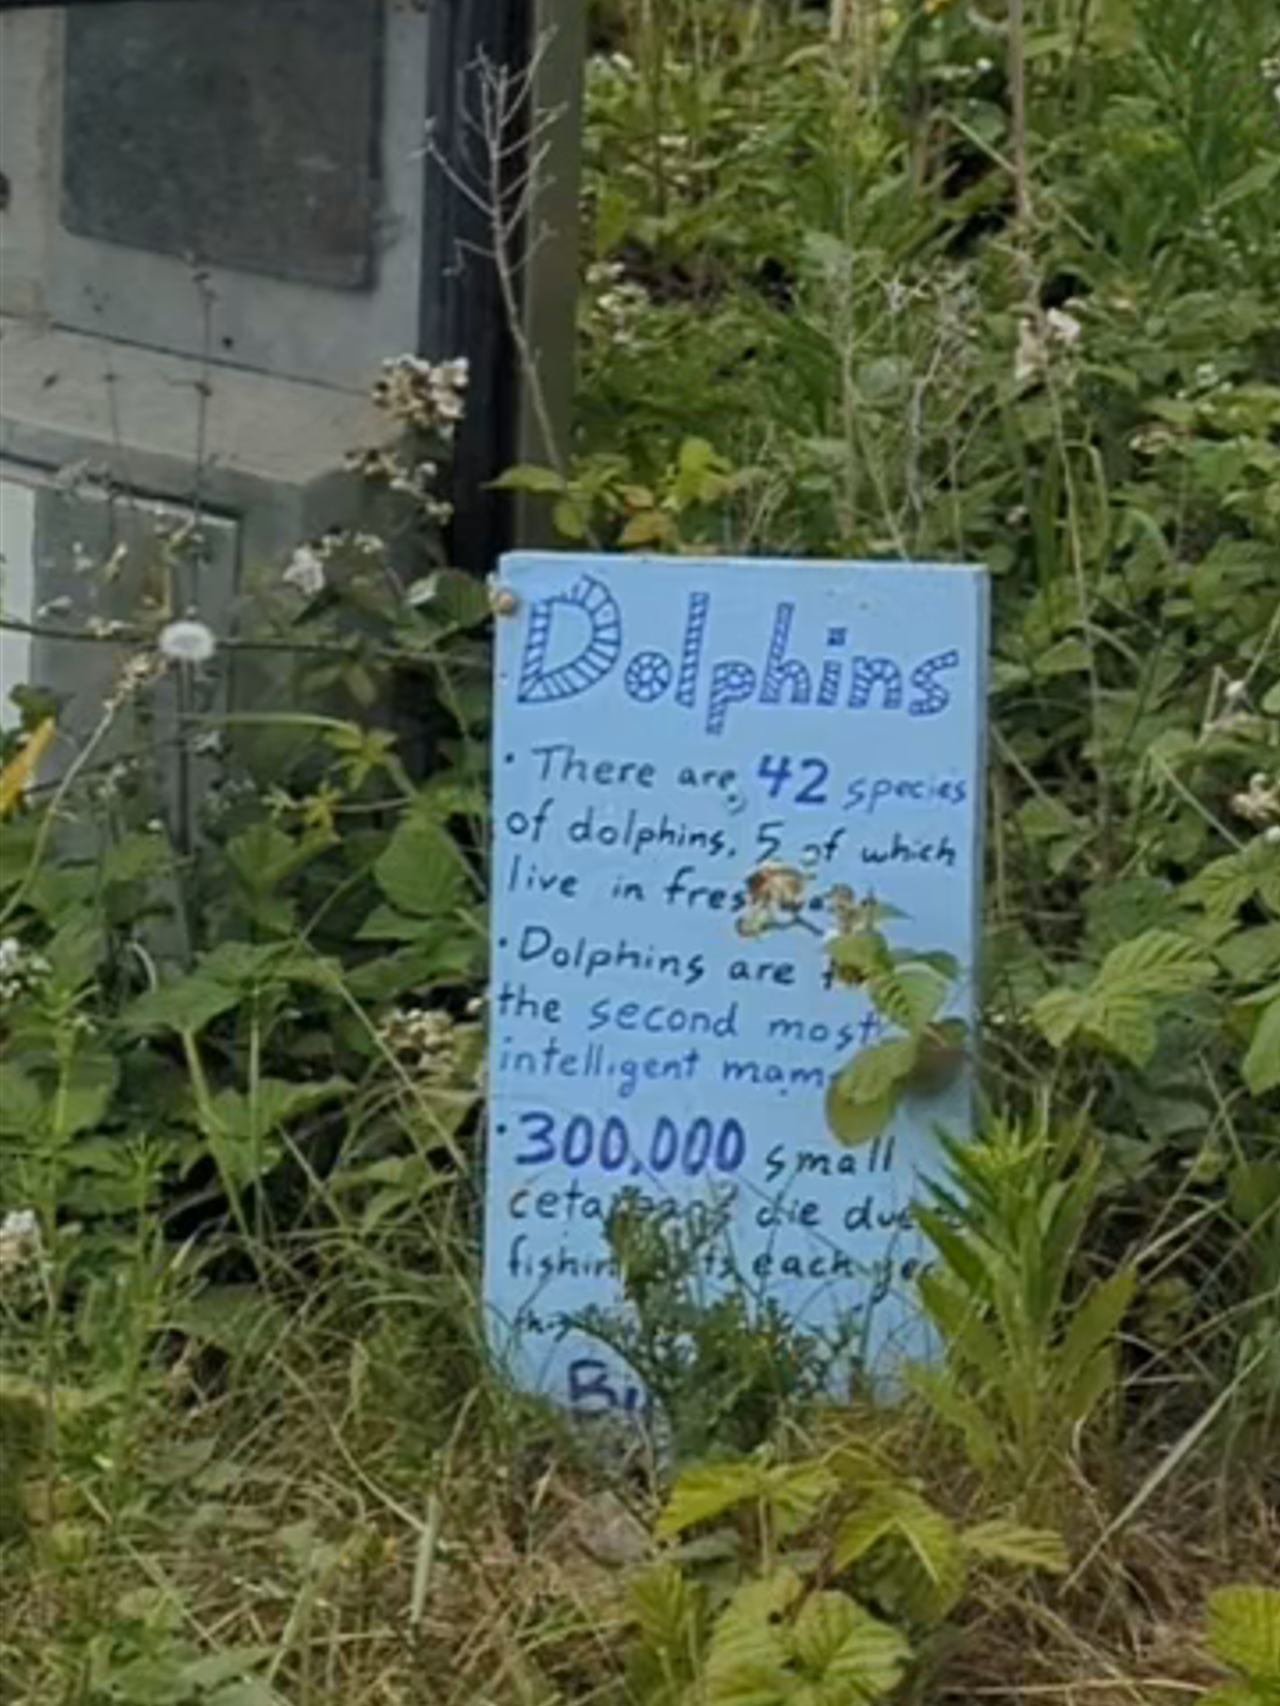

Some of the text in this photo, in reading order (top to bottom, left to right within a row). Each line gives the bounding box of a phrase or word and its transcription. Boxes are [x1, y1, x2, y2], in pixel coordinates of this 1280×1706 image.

[516, 573, 960, 736] Dolphins
[531, 743, 657, 789] There
[756, 753, 831, 806] 42
[841, 772, 968, 814] species
[506, 797, 555, 843] of
[755, 820, 786, 864] 5
[802, 826, 847, 867] of
[860, 832, 957, 868] which
[506, 855, 578, 899] live
[611, 876, 645, 901] in
[518, 925, 707, 986] Dolphins
[728, 959, 797, 985] are
[499, 983, 880, 1052] the second most
[498, 1037, 701, 1098] intelligent
[514, 1110, 896, 1184] 300,000 small
[755, 1193, 822, 1229] die
[508, 1233, 622, 1280] fishin
[751, 1248, 856, 1279] each
